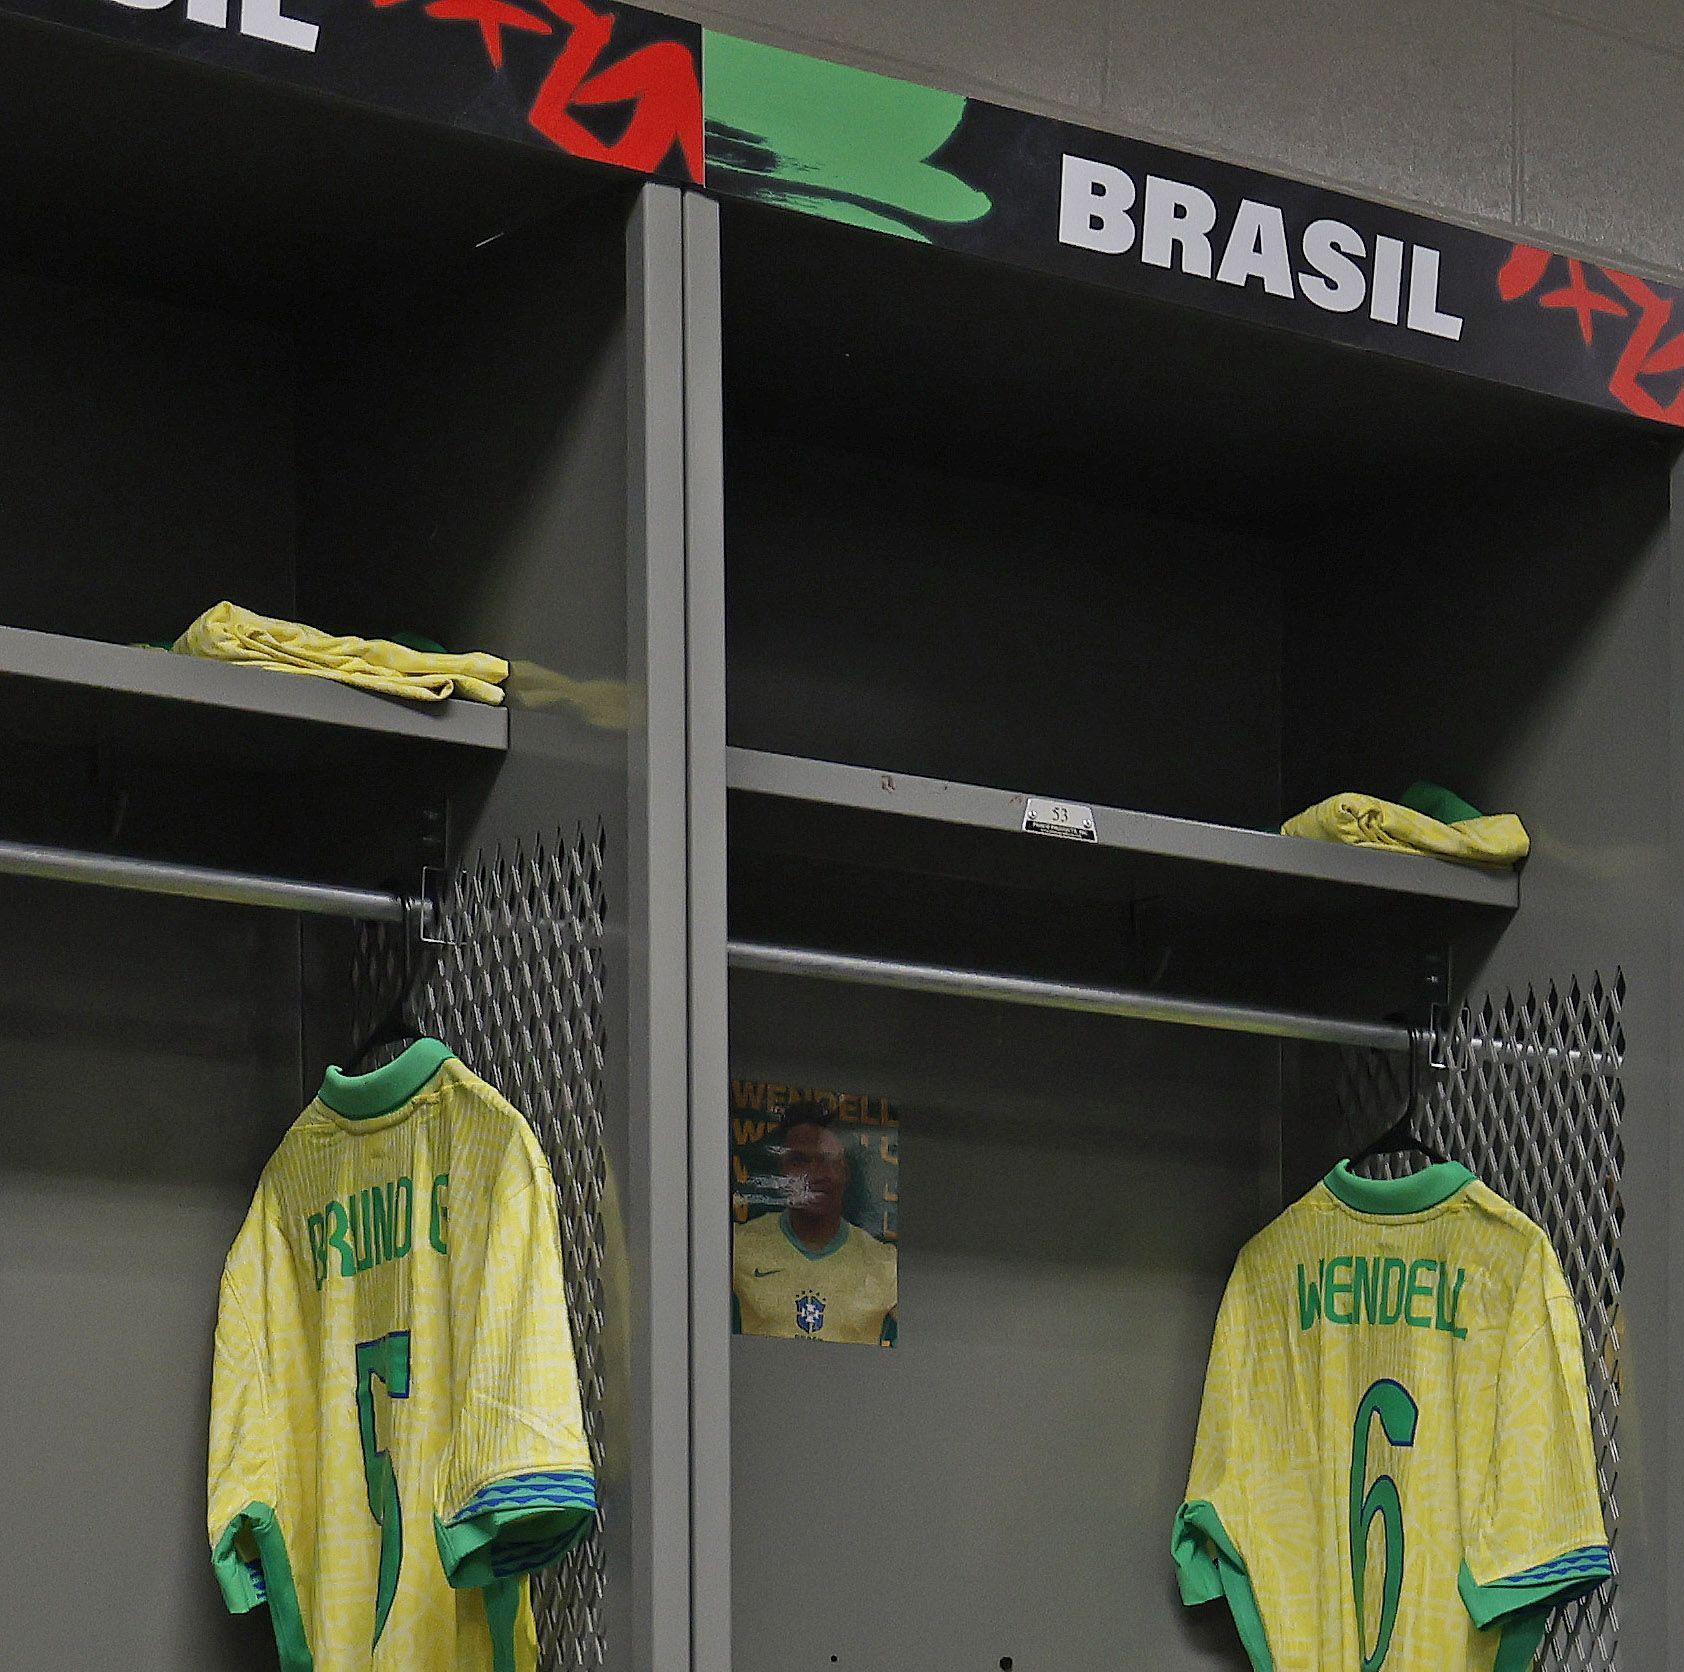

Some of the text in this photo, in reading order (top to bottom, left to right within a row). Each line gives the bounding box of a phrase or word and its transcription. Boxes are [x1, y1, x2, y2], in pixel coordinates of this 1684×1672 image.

[1058, 153, 1463, 341] BRASIL
[308, 1175, 413, 1291] BRUNO
[1298, 1256, 1468, 1340] WENDELL
